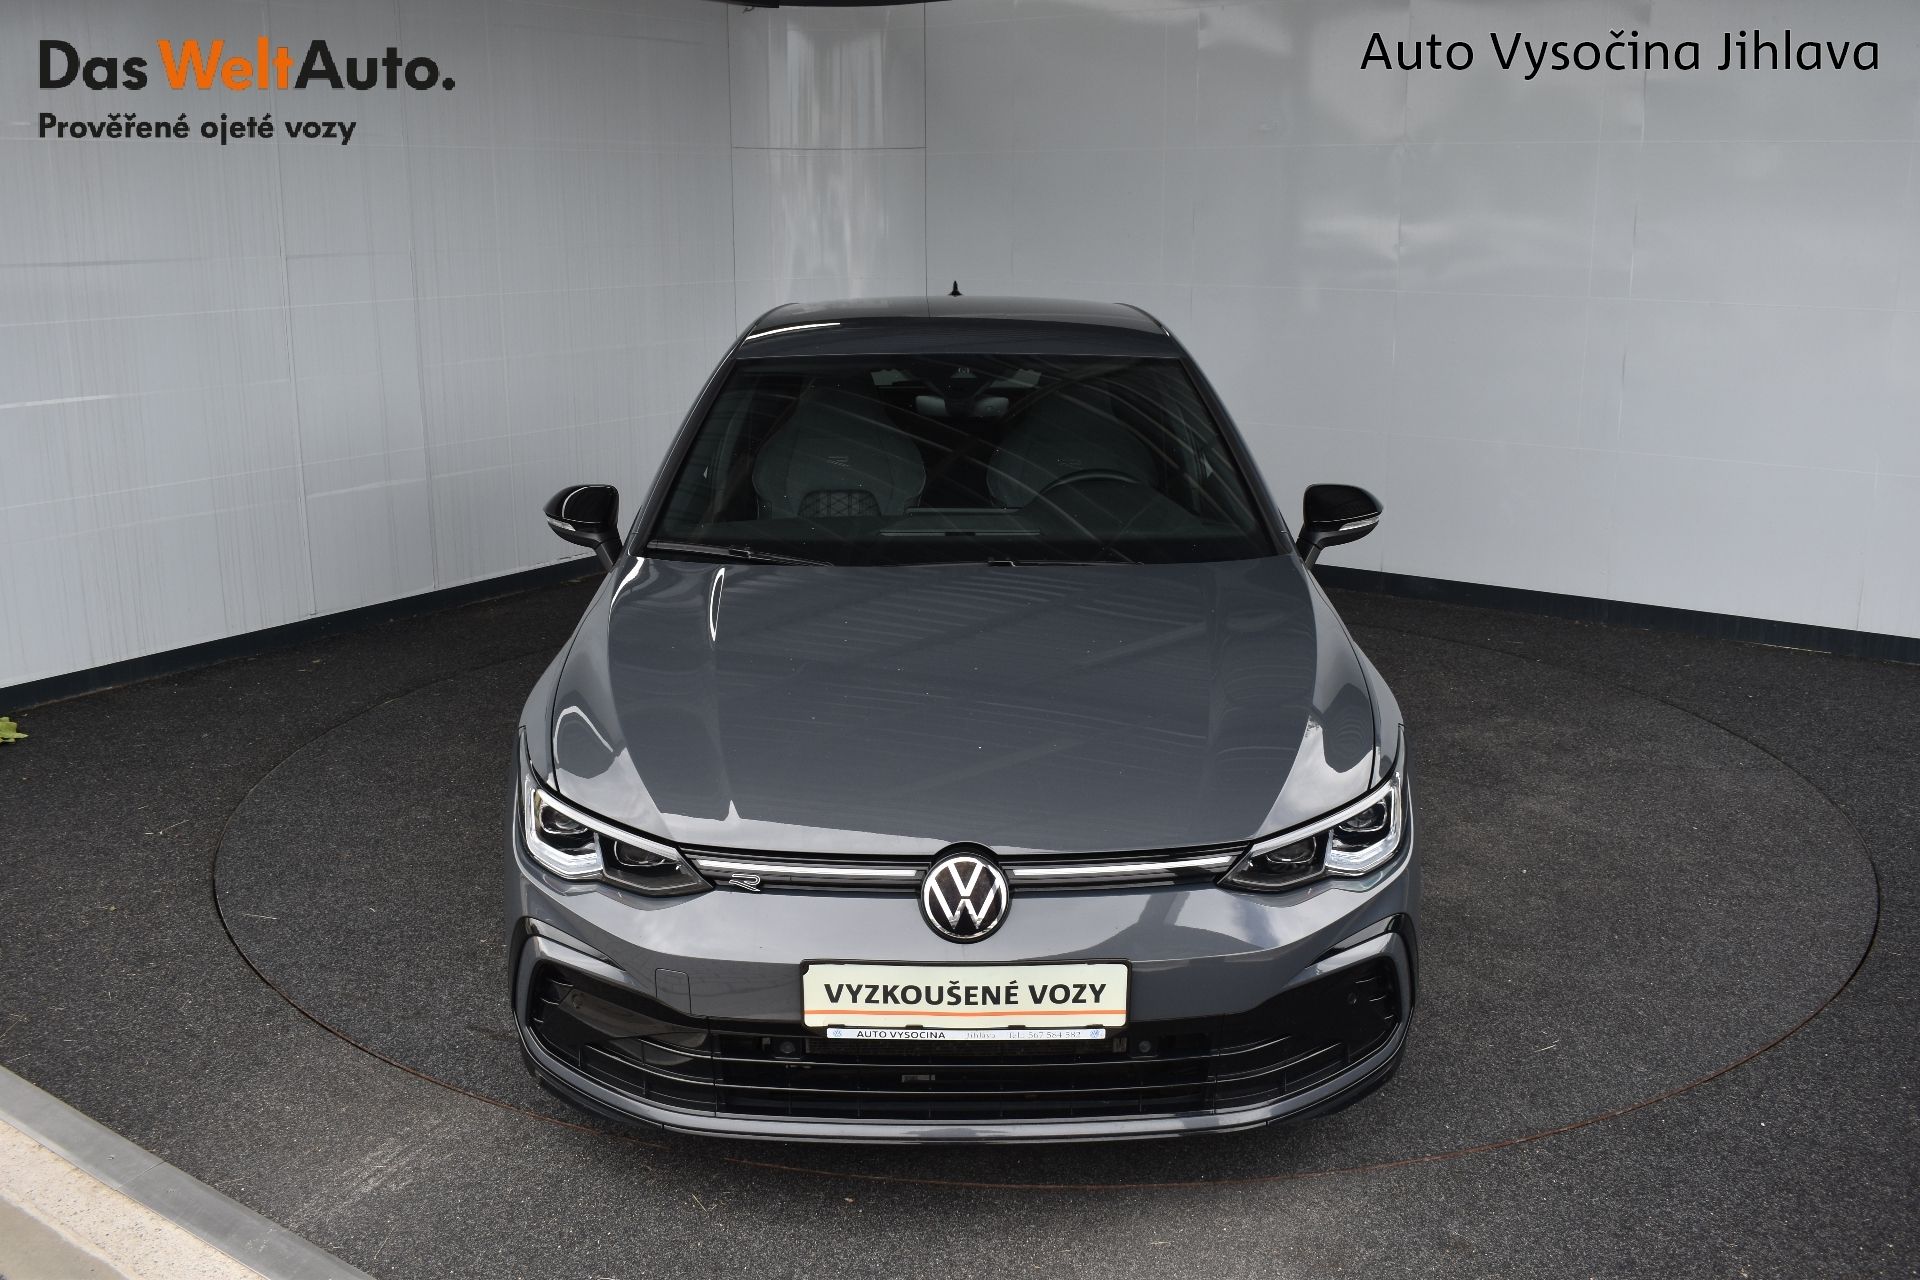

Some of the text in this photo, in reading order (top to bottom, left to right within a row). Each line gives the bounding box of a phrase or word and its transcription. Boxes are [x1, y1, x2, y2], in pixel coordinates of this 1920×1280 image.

[823, 979, 1107, 1006] VYZKOUŠENÉ VOZY
[857, 1030, 887, 1038] AUTO
